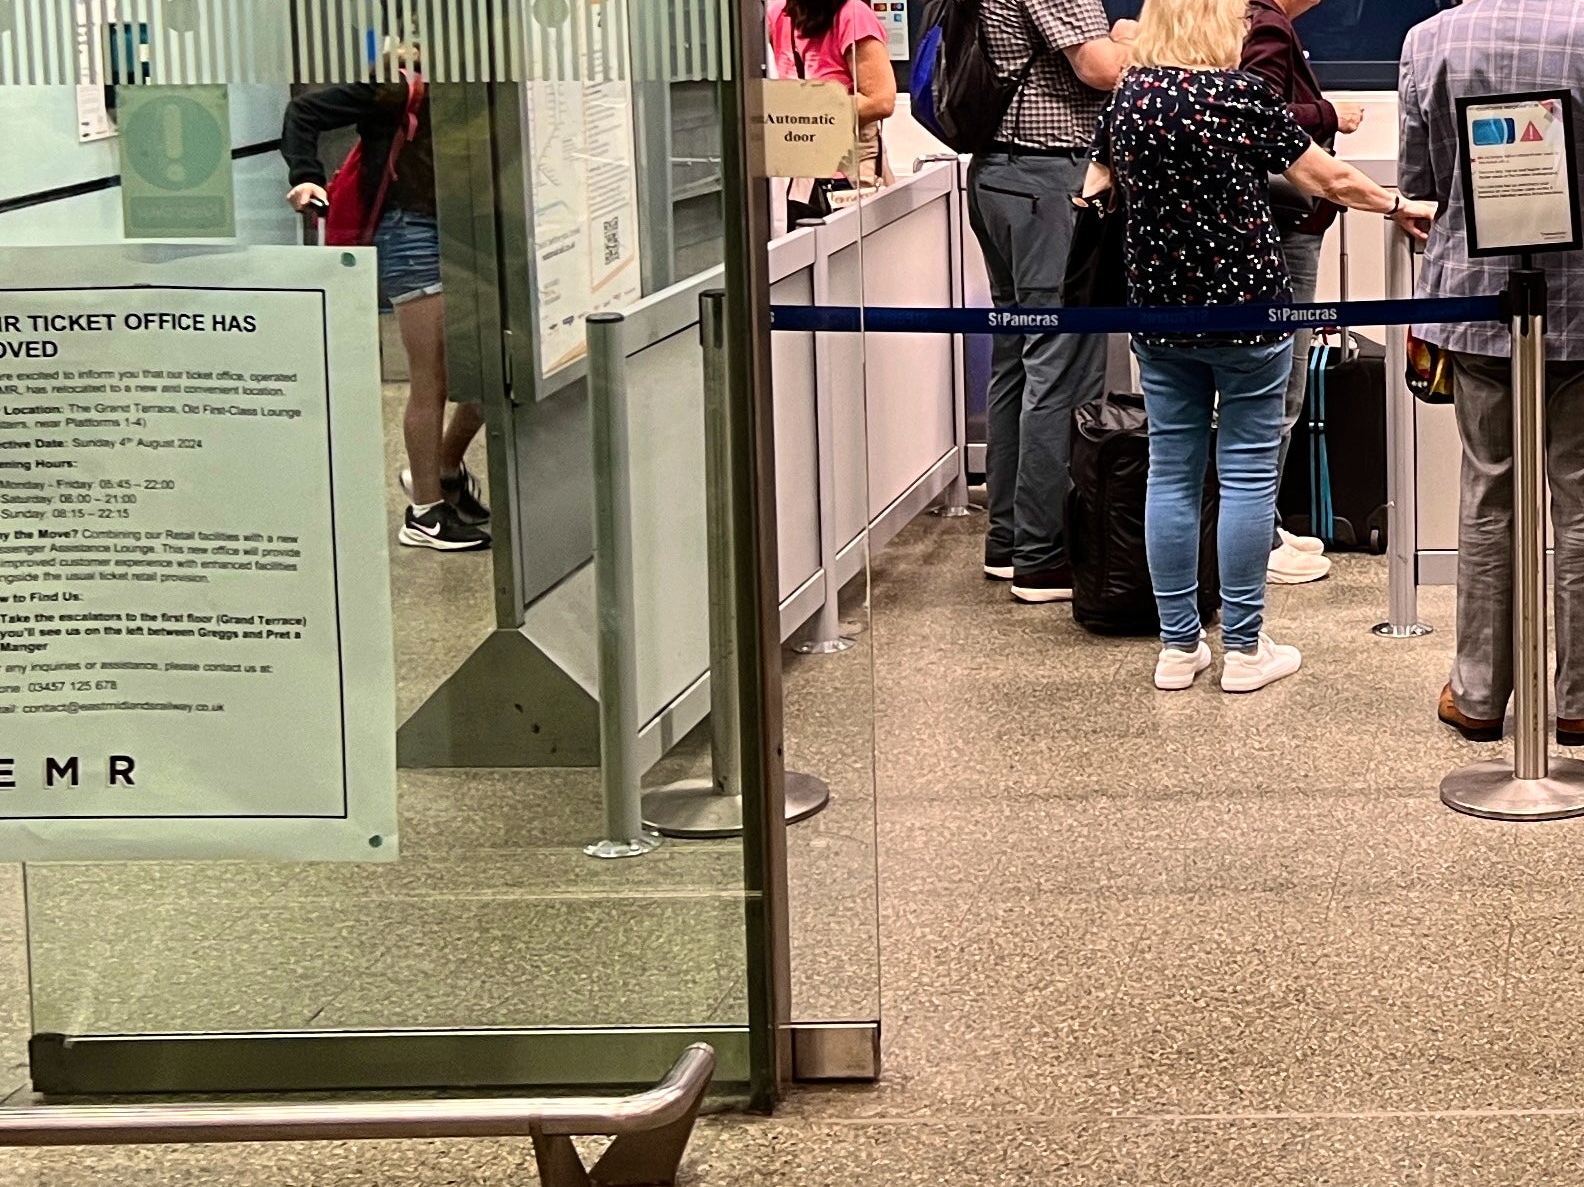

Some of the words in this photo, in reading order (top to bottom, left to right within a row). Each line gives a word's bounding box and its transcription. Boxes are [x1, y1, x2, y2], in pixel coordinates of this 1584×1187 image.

[763, 113, 836, 125] Automatic
[784, 130, 817, 143] door
[27, 314, 116, 331] TICKET
[125, 313, 205, 331] OFFICE
[213, 315, 256, 332] HAS
[0, 341, 57, 358] VED
[29, 590, 58, 602] Find
[0, 755, 136, 788] EMR
